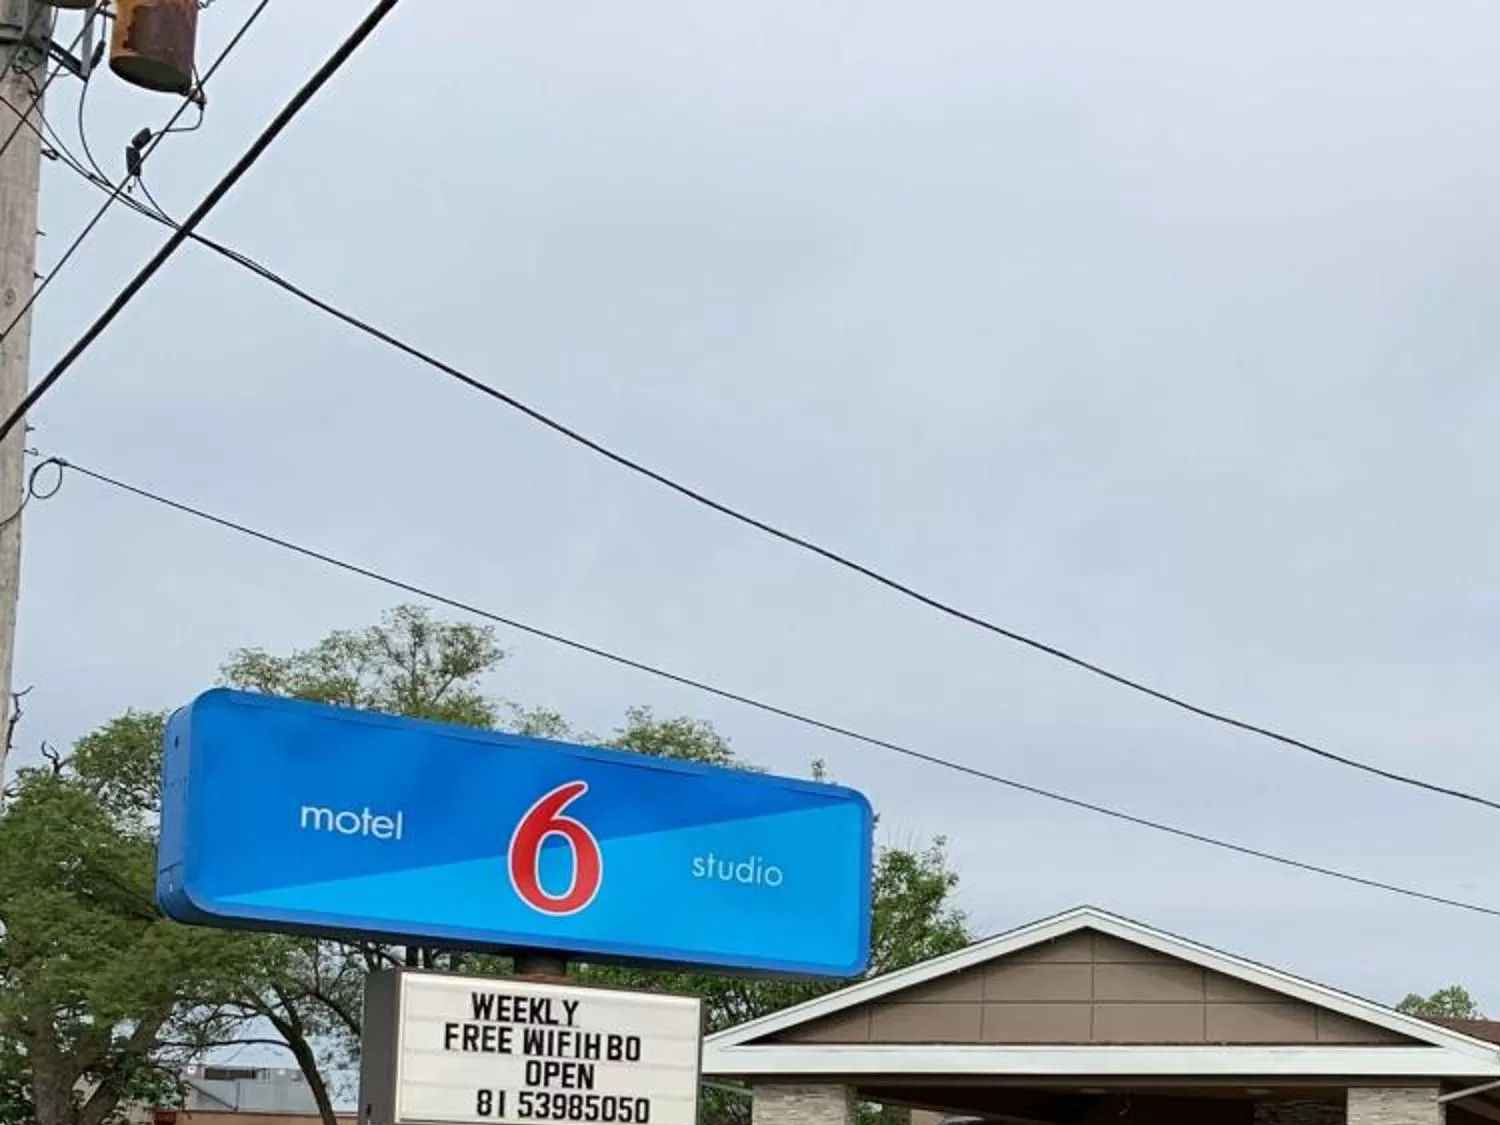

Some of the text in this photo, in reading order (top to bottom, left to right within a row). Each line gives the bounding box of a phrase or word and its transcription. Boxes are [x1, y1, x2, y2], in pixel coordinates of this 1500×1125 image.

[299, 780, 784, 917] motel 6 studio
[471, 992, 579, 1026] WEEKLY
[444, 1023, 513, 1053] FREE
[525, 1060, 595, 1090] OPEN
